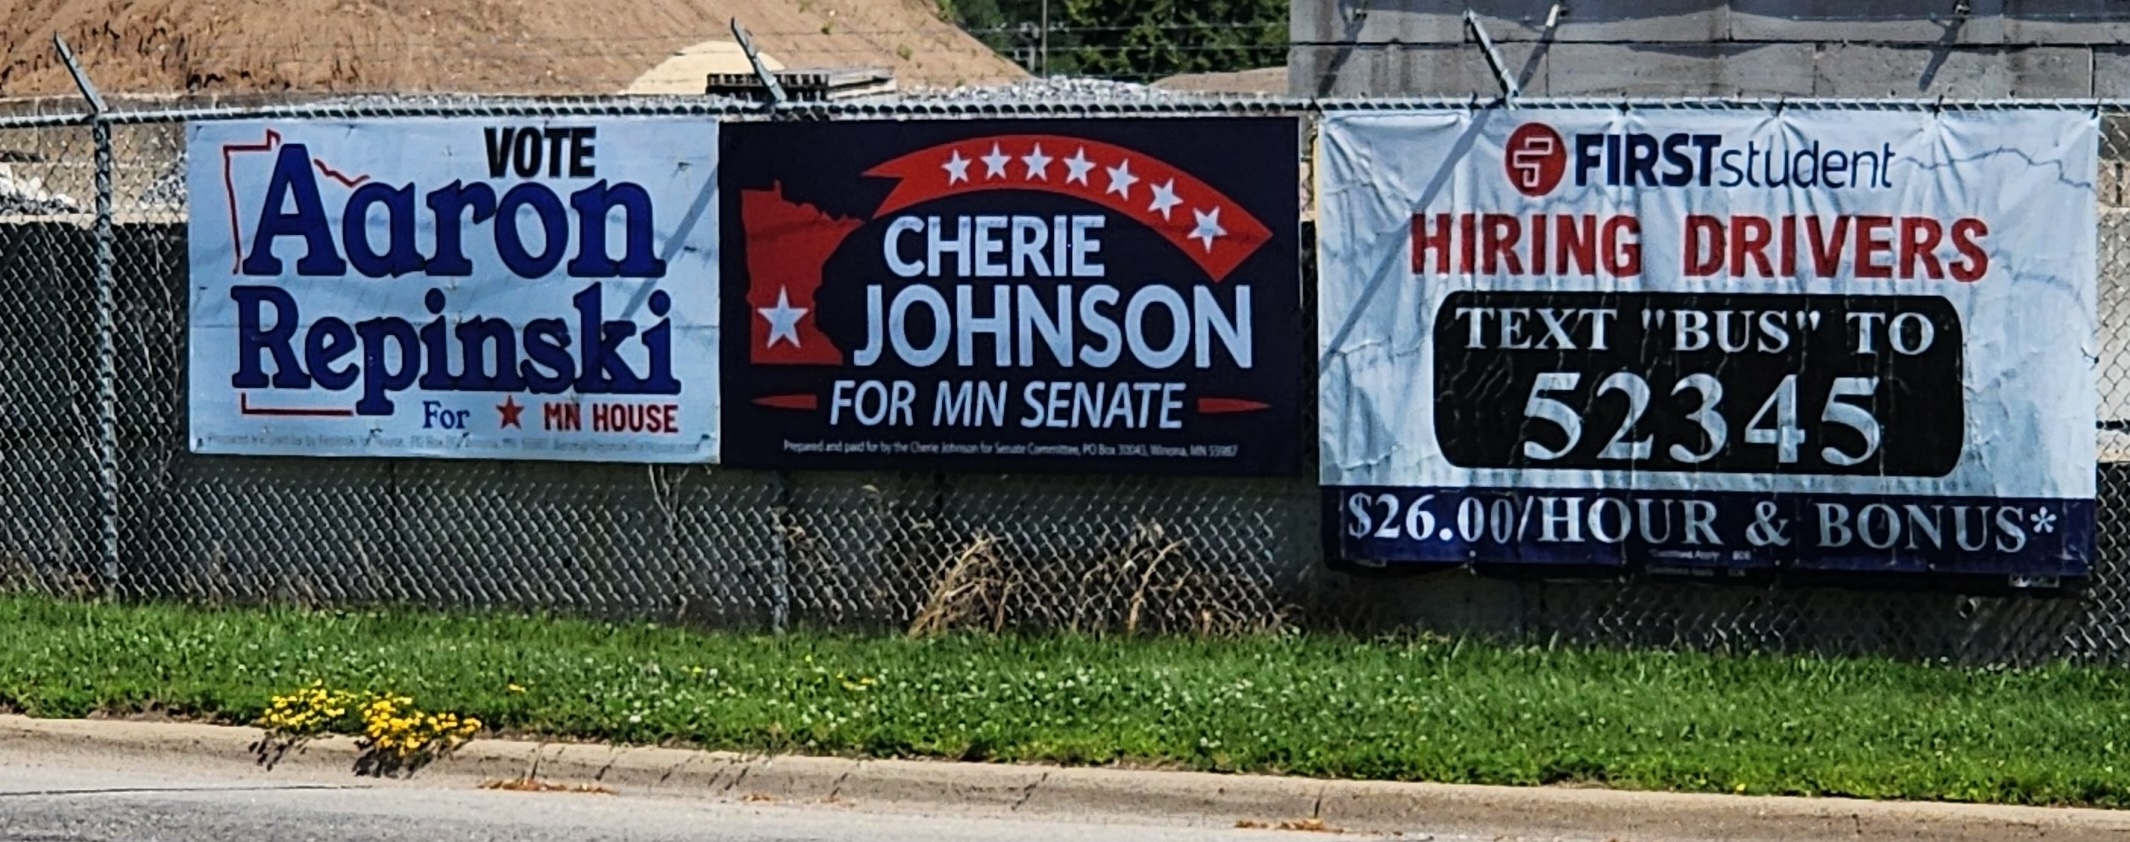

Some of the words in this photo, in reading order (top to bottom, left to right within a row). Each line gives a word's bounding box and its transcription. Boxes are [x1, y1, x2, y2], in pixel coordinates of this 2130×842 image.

[484, 126, 596, 179] VOTE
[242, 143, 667, 279] Aaron
[884, 215, 1105, 278] CHERIE
[1409, 213, 1642, 278] HIRING
[1683, 215, 1989, 283] DRIVERS
[231, 282, 682, 416] Repinski
[853, 284, 1252, 369] JOHNSON
[1454, 307, 1617, 350] TEXT
[1640, 309, 1821, 354] "BUS"
[1844, 311, 1935, 356] TO
[422, 401, 470, 431] For
[543, 402, 581, 431] MN
[592, 403, 679, 433] HOUSE
[829, 380, 915, 427] FOR
[933, 381, 1007, 428] MN
[1021, 382, 1187, 429] SENATE
[1522, 371, 1880, 467] 52345
[784, 439, 824, 454] Prepared
[826, 440, 842, 453] and
[844, 440, 865, 455] paid
[910, 441, 939, 454] Cherie
[941, 441, 978, 454] Johnson
[1083, 443, 1097, 456] PO
[1099, 444, 1115, 456] Box
[1348, 492, 1724, 546] $26.00/HOUR
[1745, 501, 1791, 547] &
